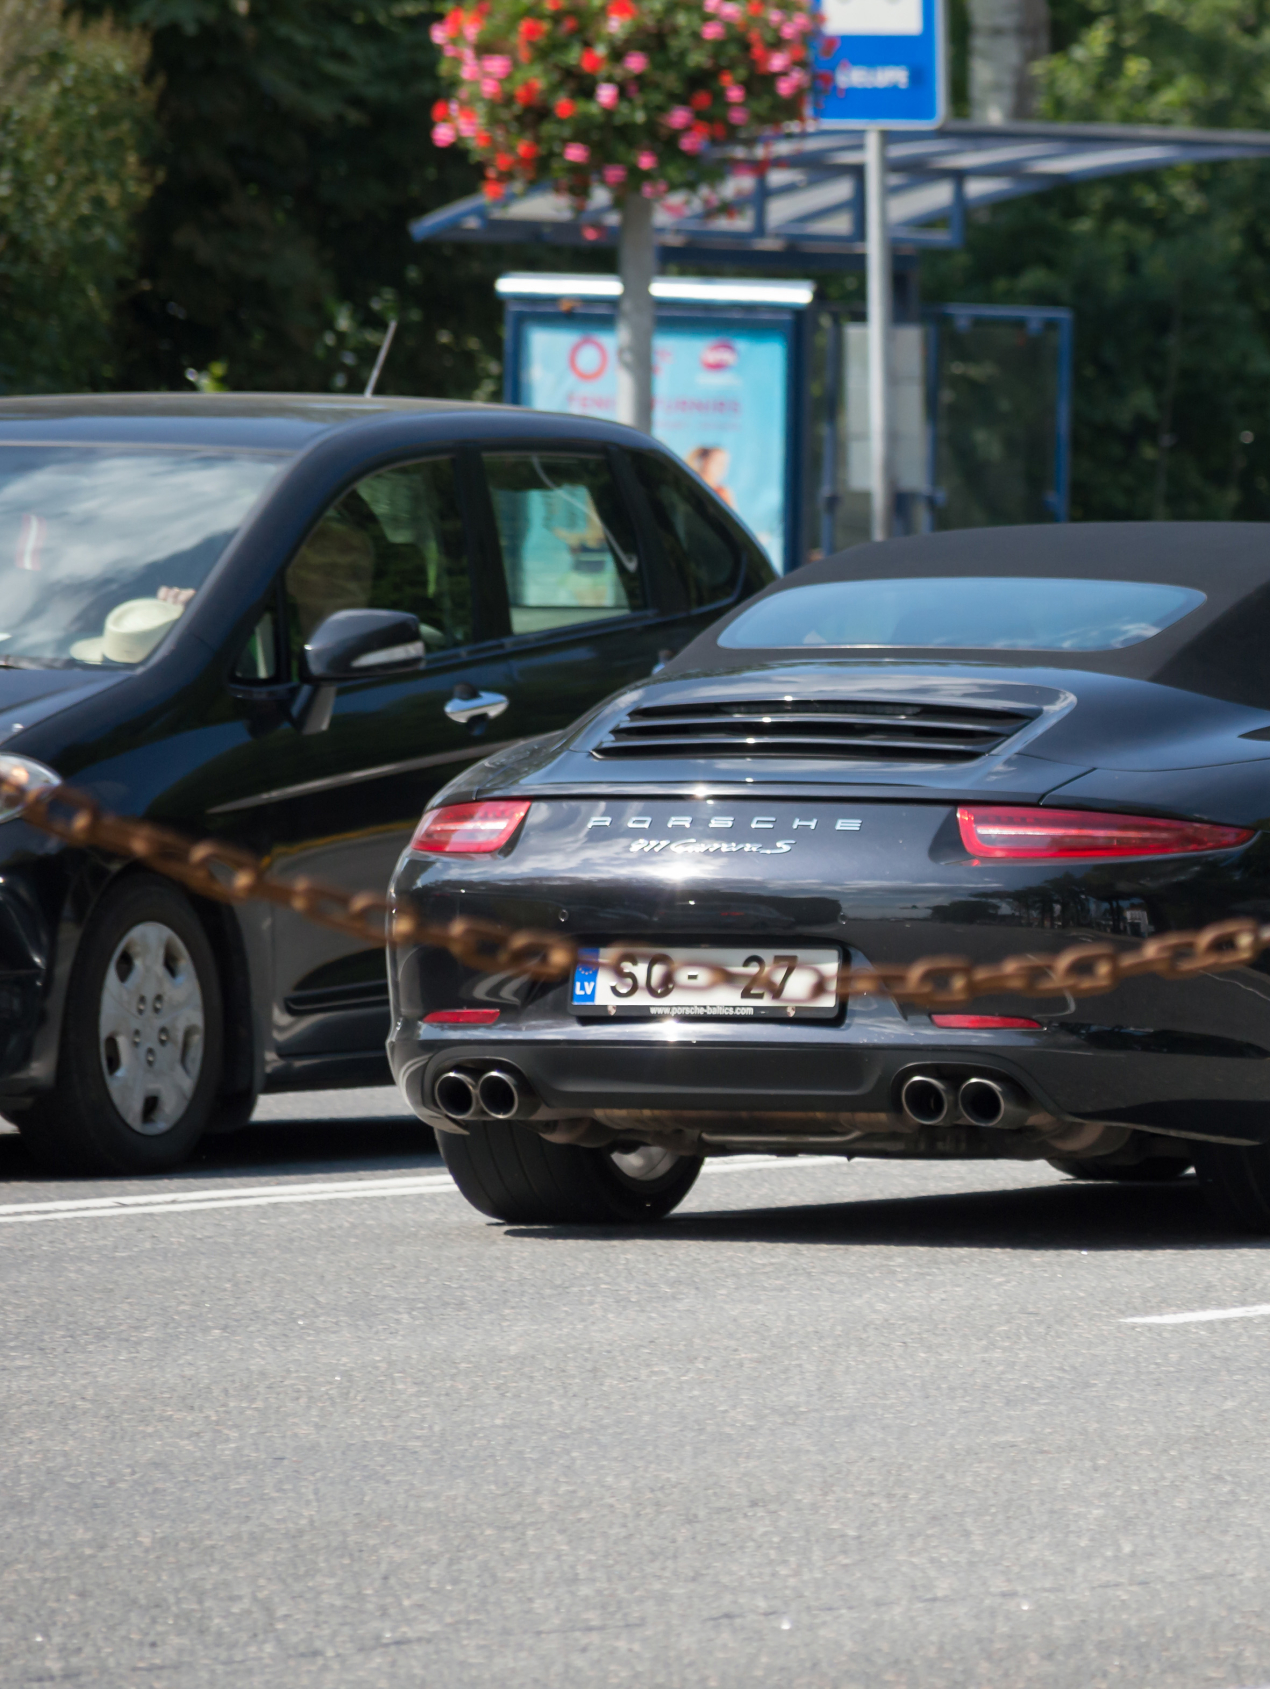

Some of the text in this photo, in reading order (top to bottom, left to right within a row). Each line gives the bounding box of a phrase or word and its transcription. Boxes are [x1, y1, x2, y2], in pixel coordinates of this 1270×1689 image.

[587, 815, 862, 831] PORSCHE
[629, 838, 797, 854] 911 Carrera S
[575, 981, 595, 995] LV
[649, 1005, 754, 1017] www.porsche-baltics.com
